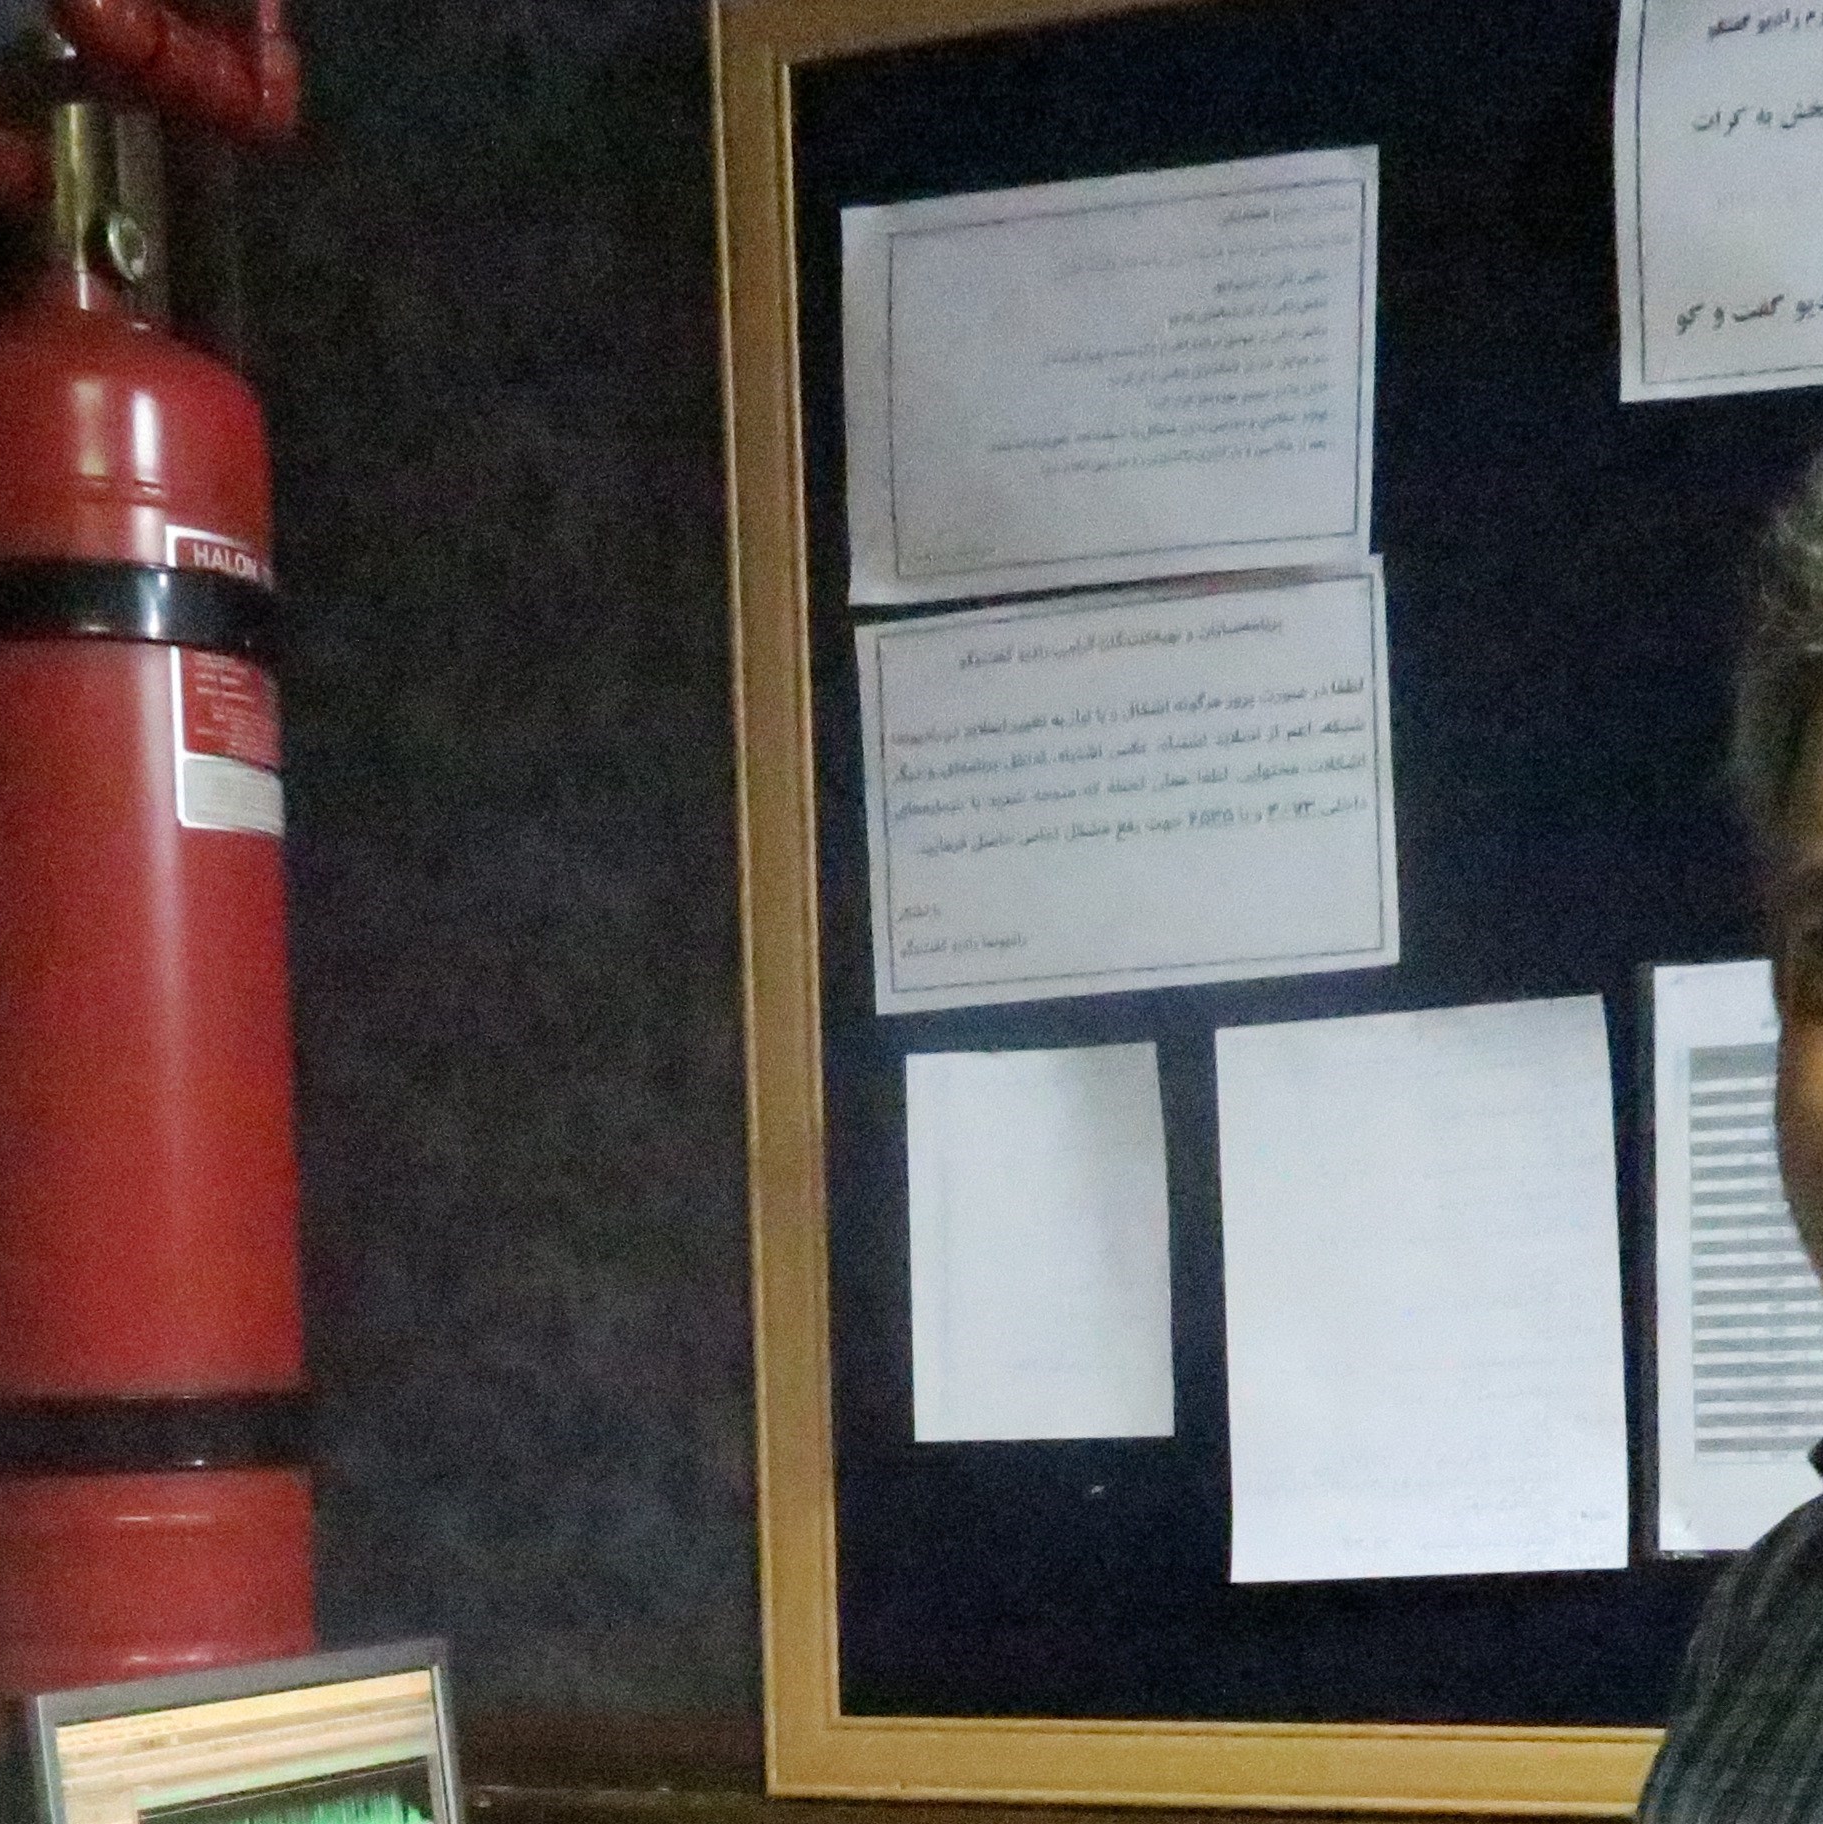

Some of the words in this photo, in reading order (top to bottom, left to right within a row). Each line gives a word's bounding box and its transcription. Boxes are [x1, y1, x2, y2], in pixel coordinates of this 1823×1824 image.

[1676, 301, 1706, 337] گو
[1711, 305, 1726, 332] و
[1731, 293, 1786, 323] گفت
[192, 542, 258, 581] HALON
